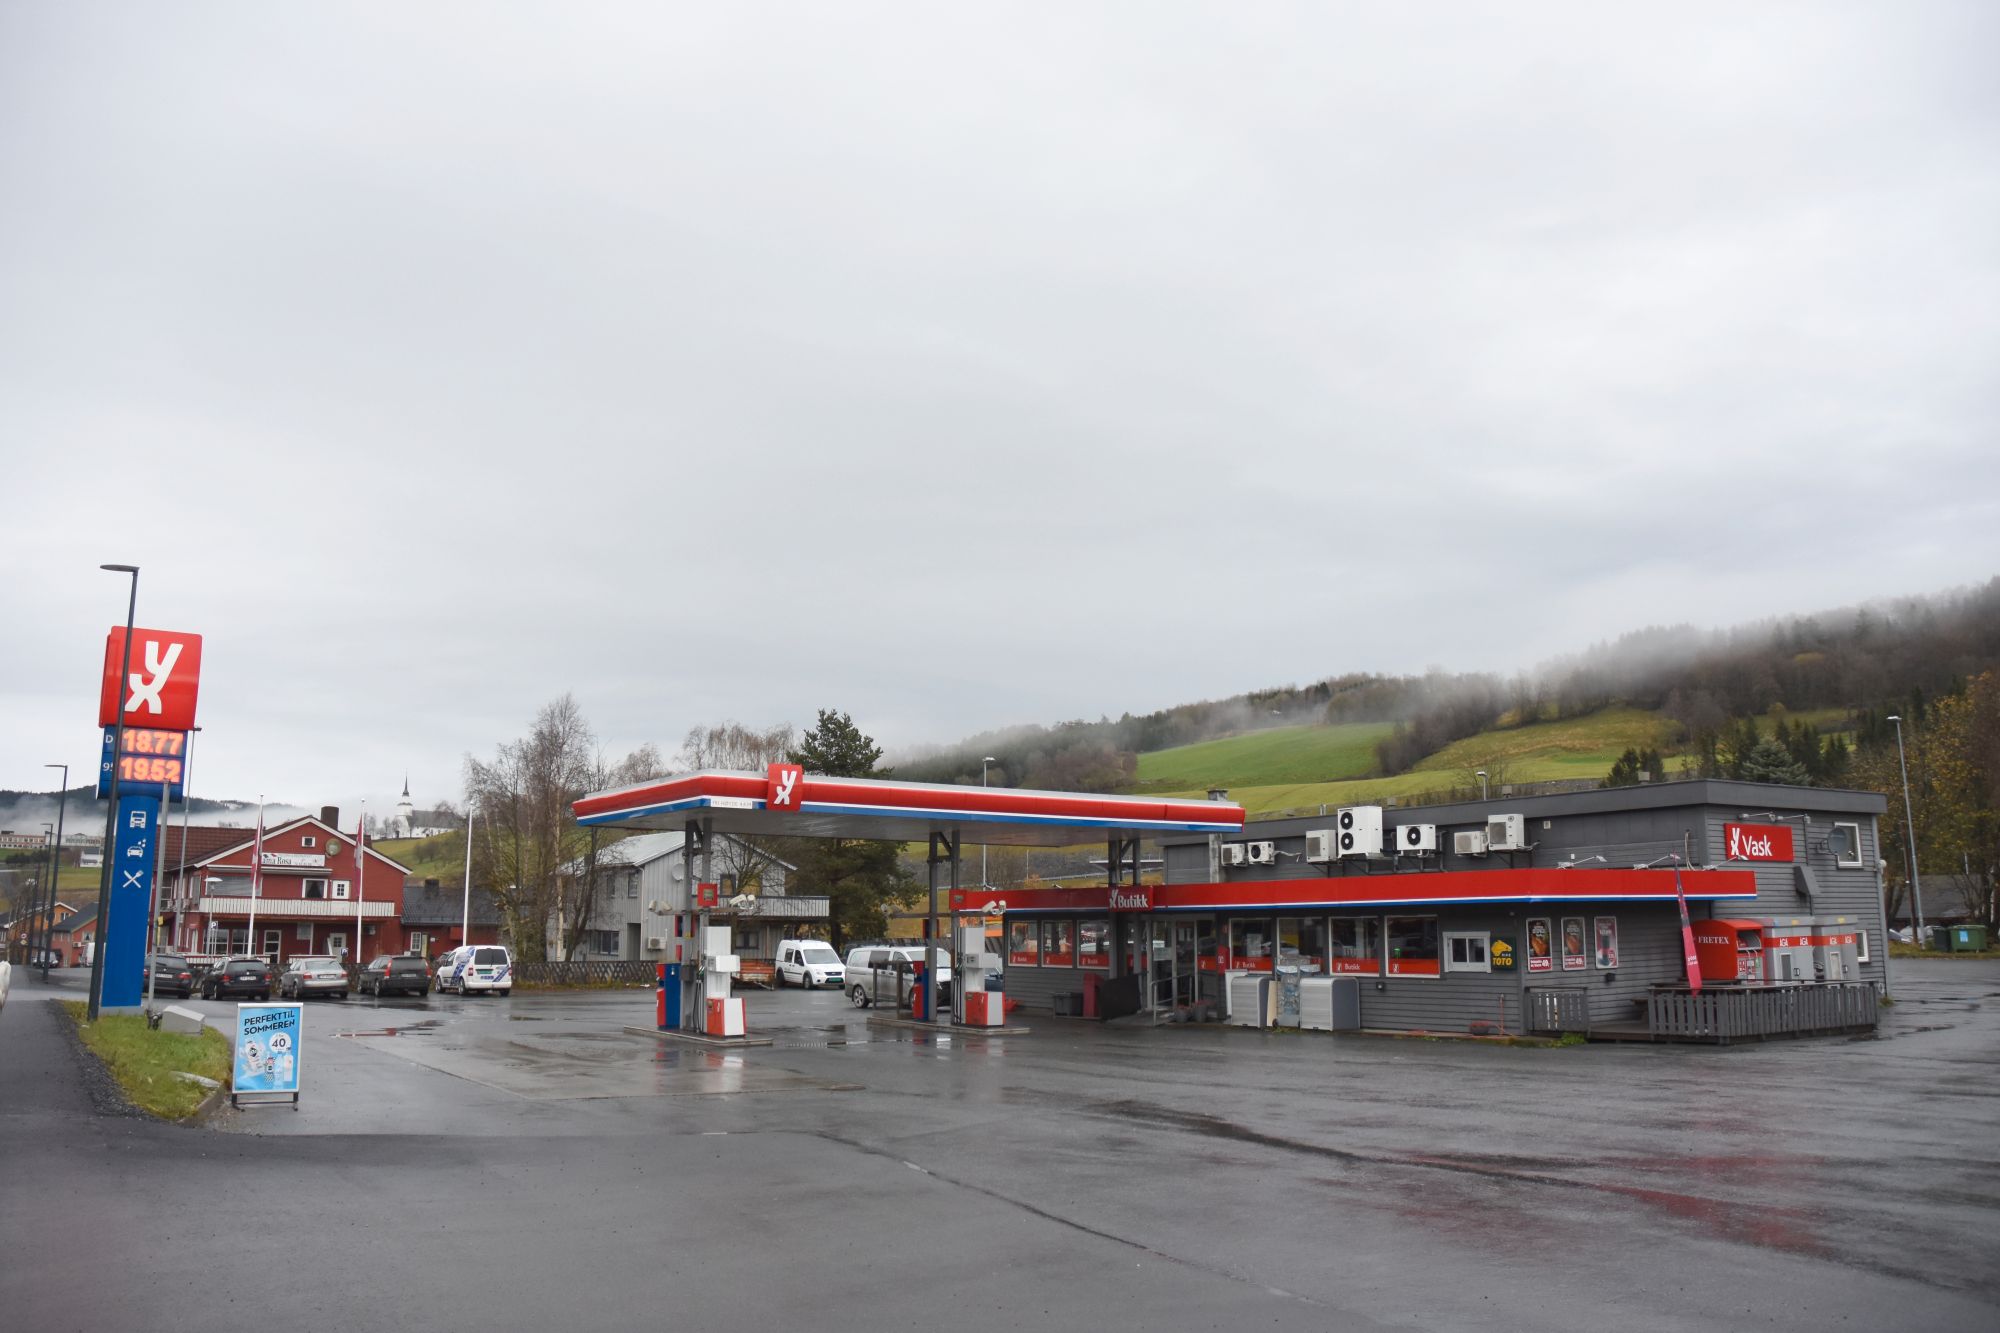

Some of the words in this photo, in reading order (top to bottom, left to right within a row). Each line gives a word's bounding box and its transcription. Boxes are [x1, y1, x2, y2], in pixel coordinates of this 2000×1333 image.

[105, 734, 114, 744] D
[1742, 835, 1773, 857] Vask
[1118, 894, 1149, 908] Butikk
[1698, 936, 1730, 945] FRETEX
[1492, 958, 1512, 966] TOTO
[244, 1012, 283, 1027] PERFEKT
[282, 1010, 295, 1019] TIL
[244, 1019, 295, 1036] SOMMEREN
[271, 1038, 287, 1048] 40
